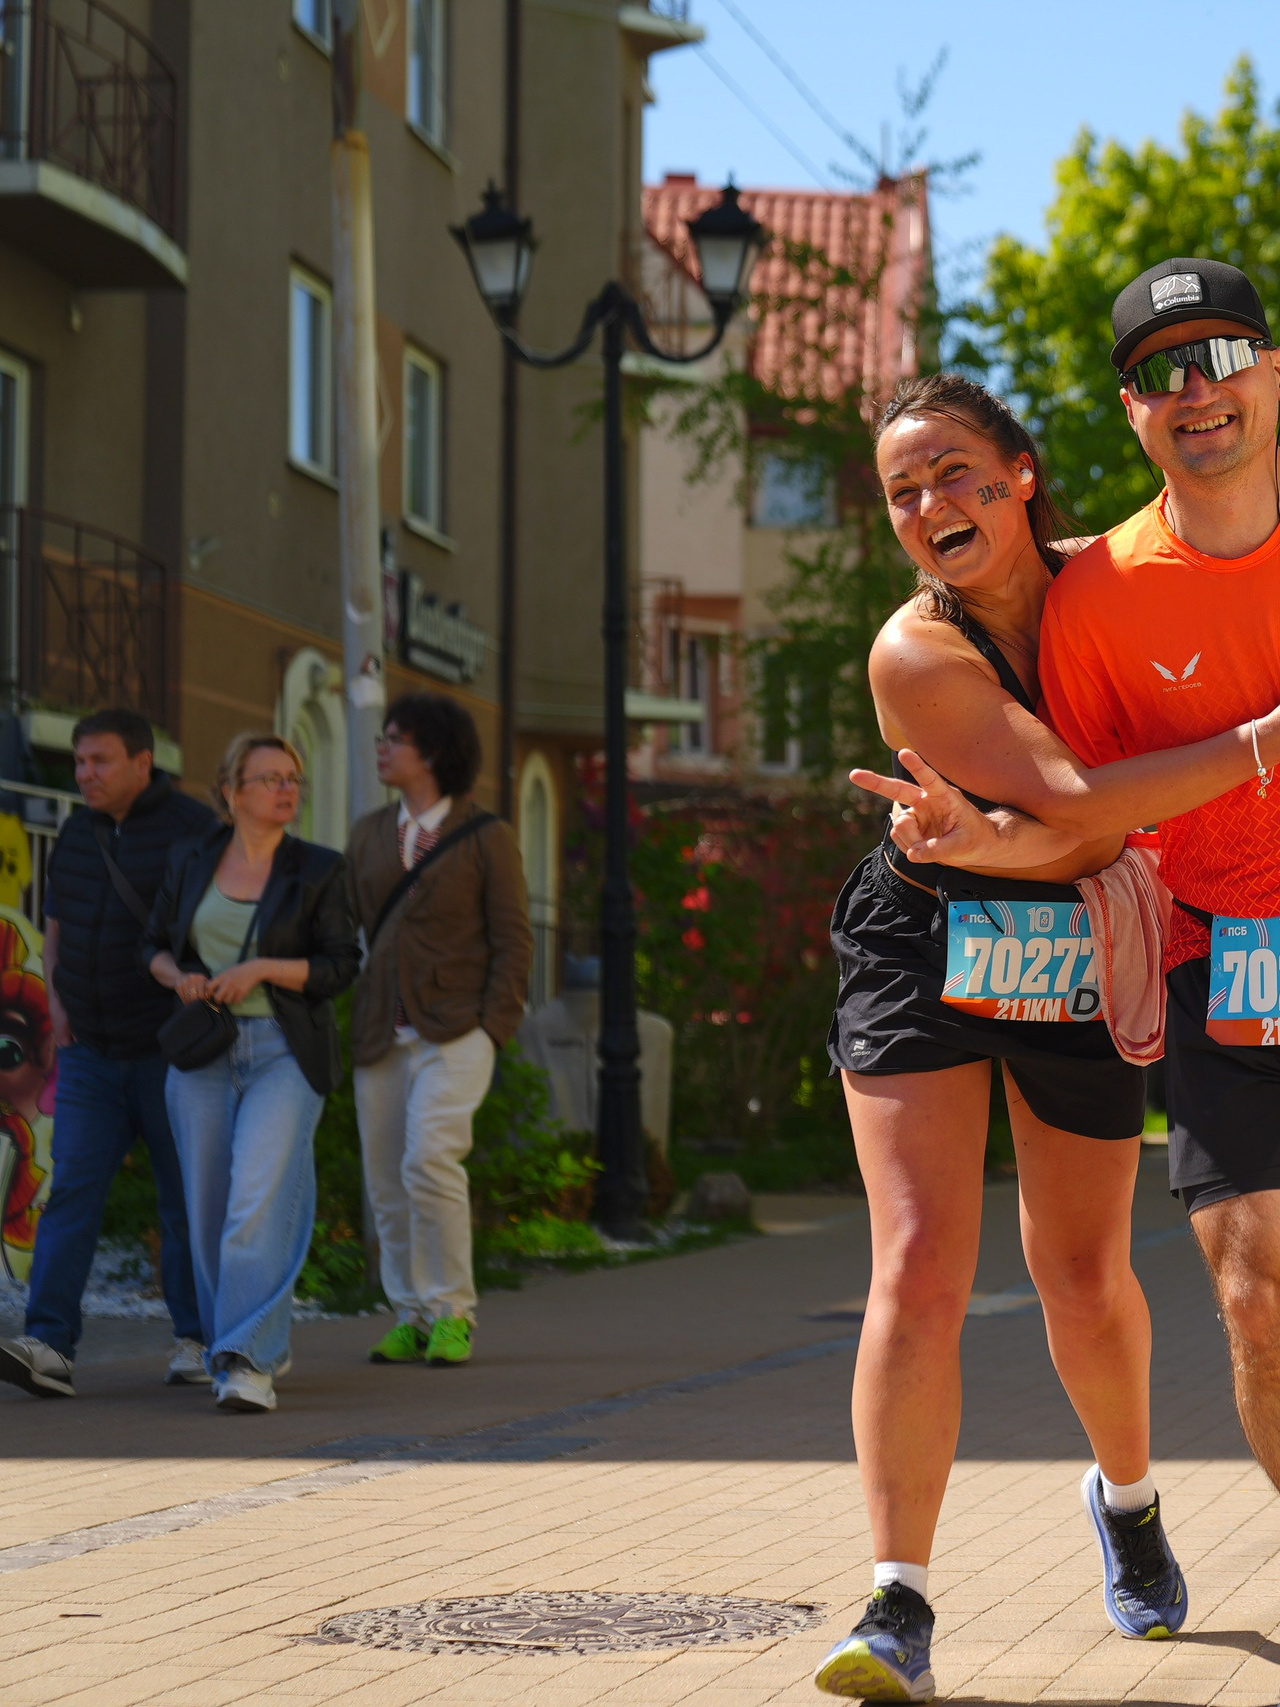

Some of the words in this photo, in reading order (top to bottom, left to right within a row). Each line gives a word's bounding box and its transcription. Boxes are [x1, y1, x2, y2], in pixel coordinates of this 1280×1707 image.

[1163, 295, 1200, 306] Columbia
[1228, 926, 1248, 937] ПСБ
[964, 937, 1098, 994] 70277
[994, 998, 1062, 1022] 21.1KM
[1071, 988, 1100, 1015] D
